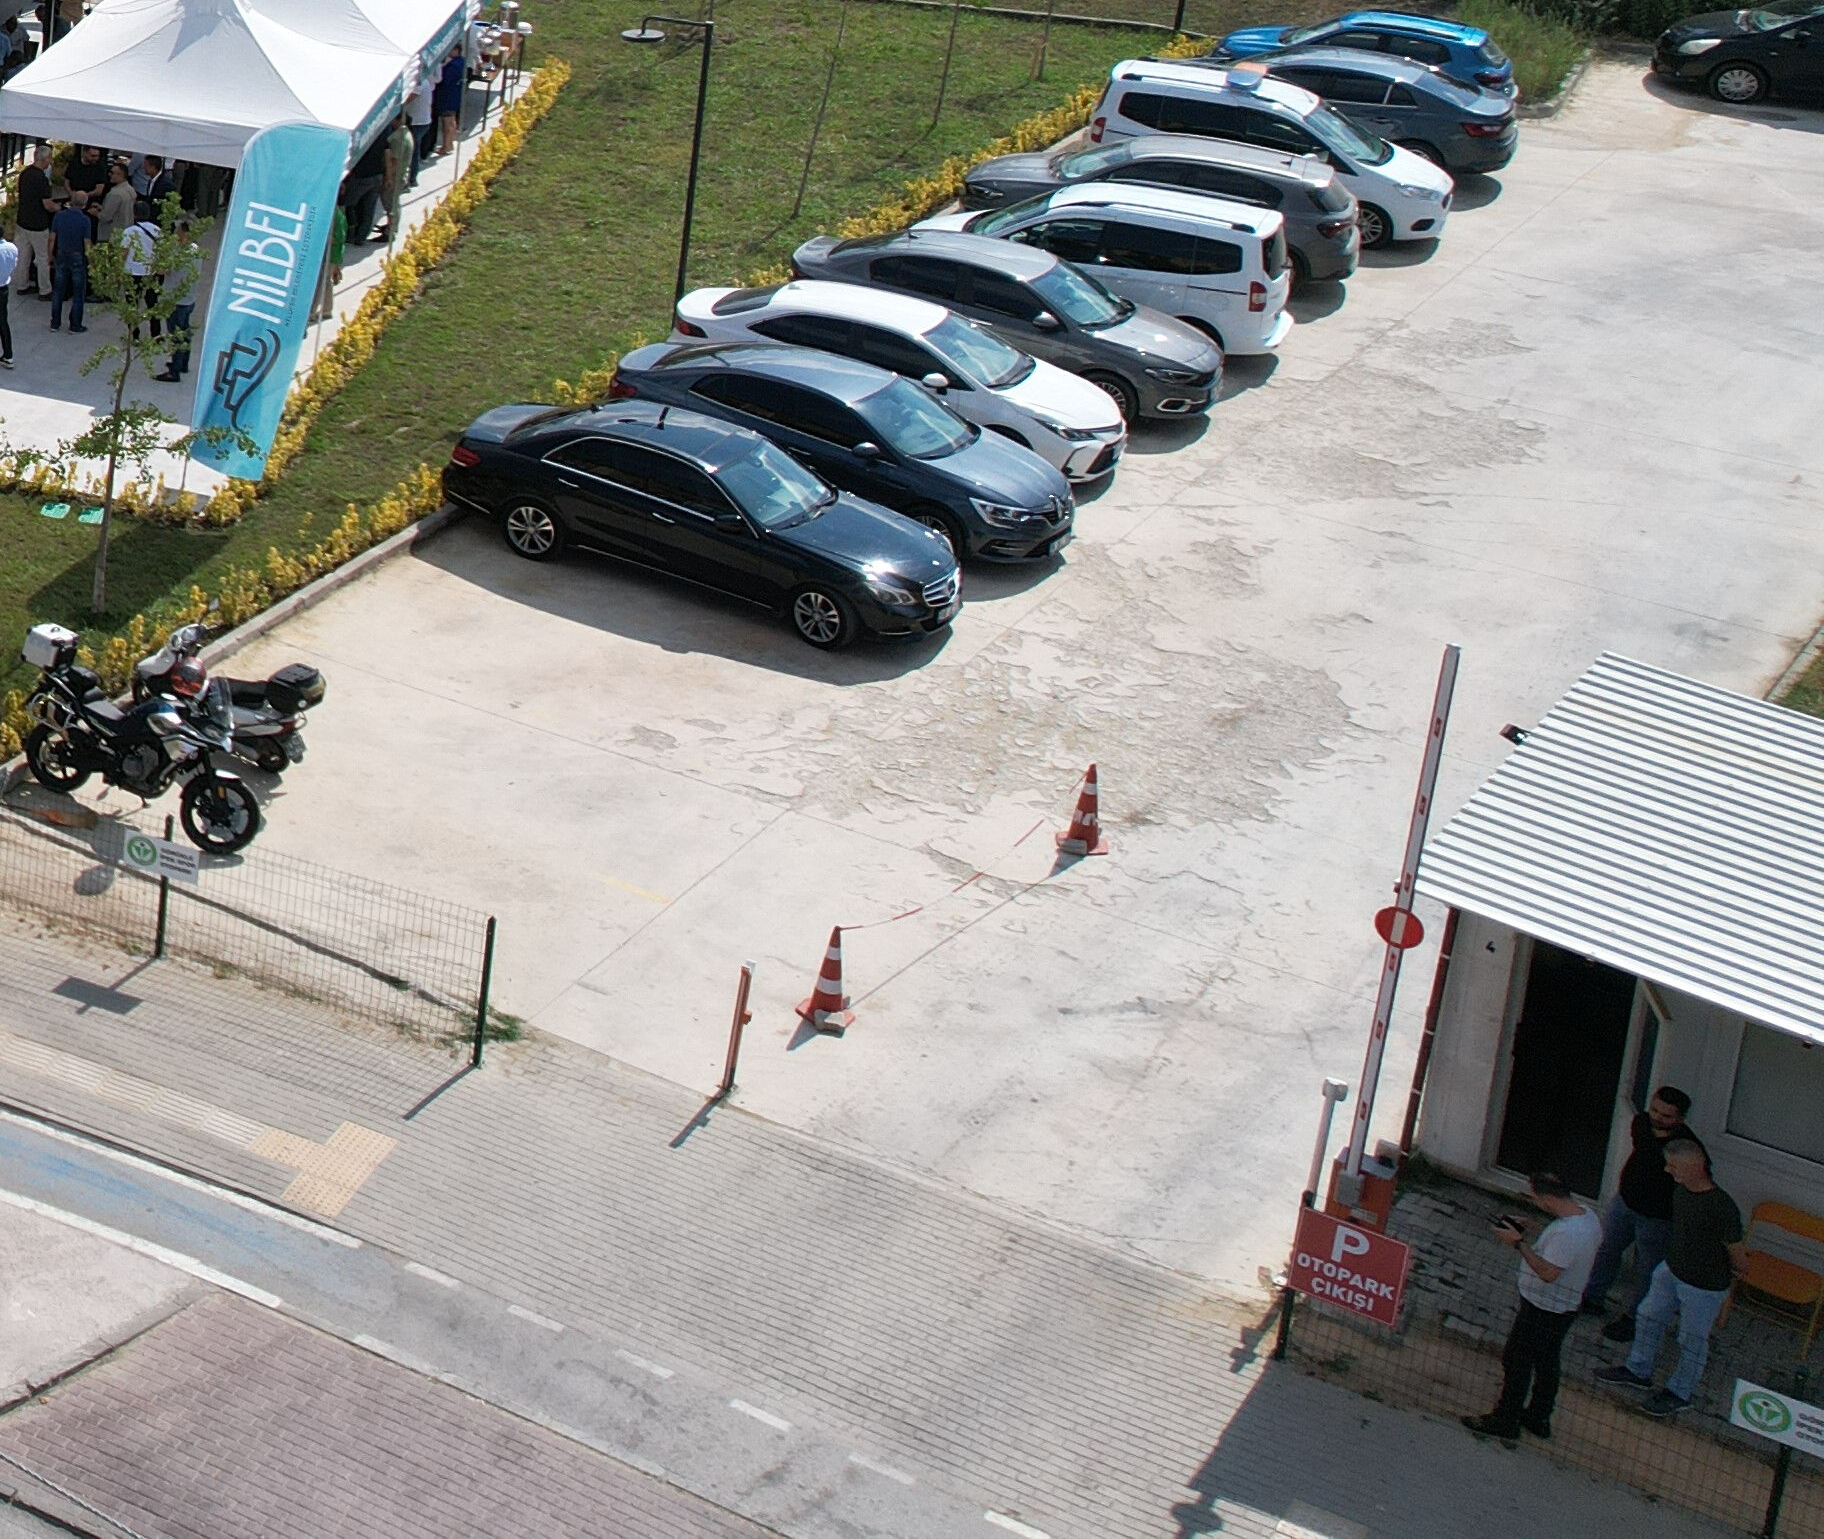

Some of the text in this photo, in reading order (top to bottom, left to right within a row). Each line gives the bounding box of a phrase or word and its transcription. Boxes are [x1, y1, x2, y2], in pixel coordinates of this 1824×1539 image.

[1331, 1225, 1370, 1263] P
[1297, 1252, 1394, 1300] OTOPARK
[1312, 1277, 1374, 1311] ÇIKIŞI
